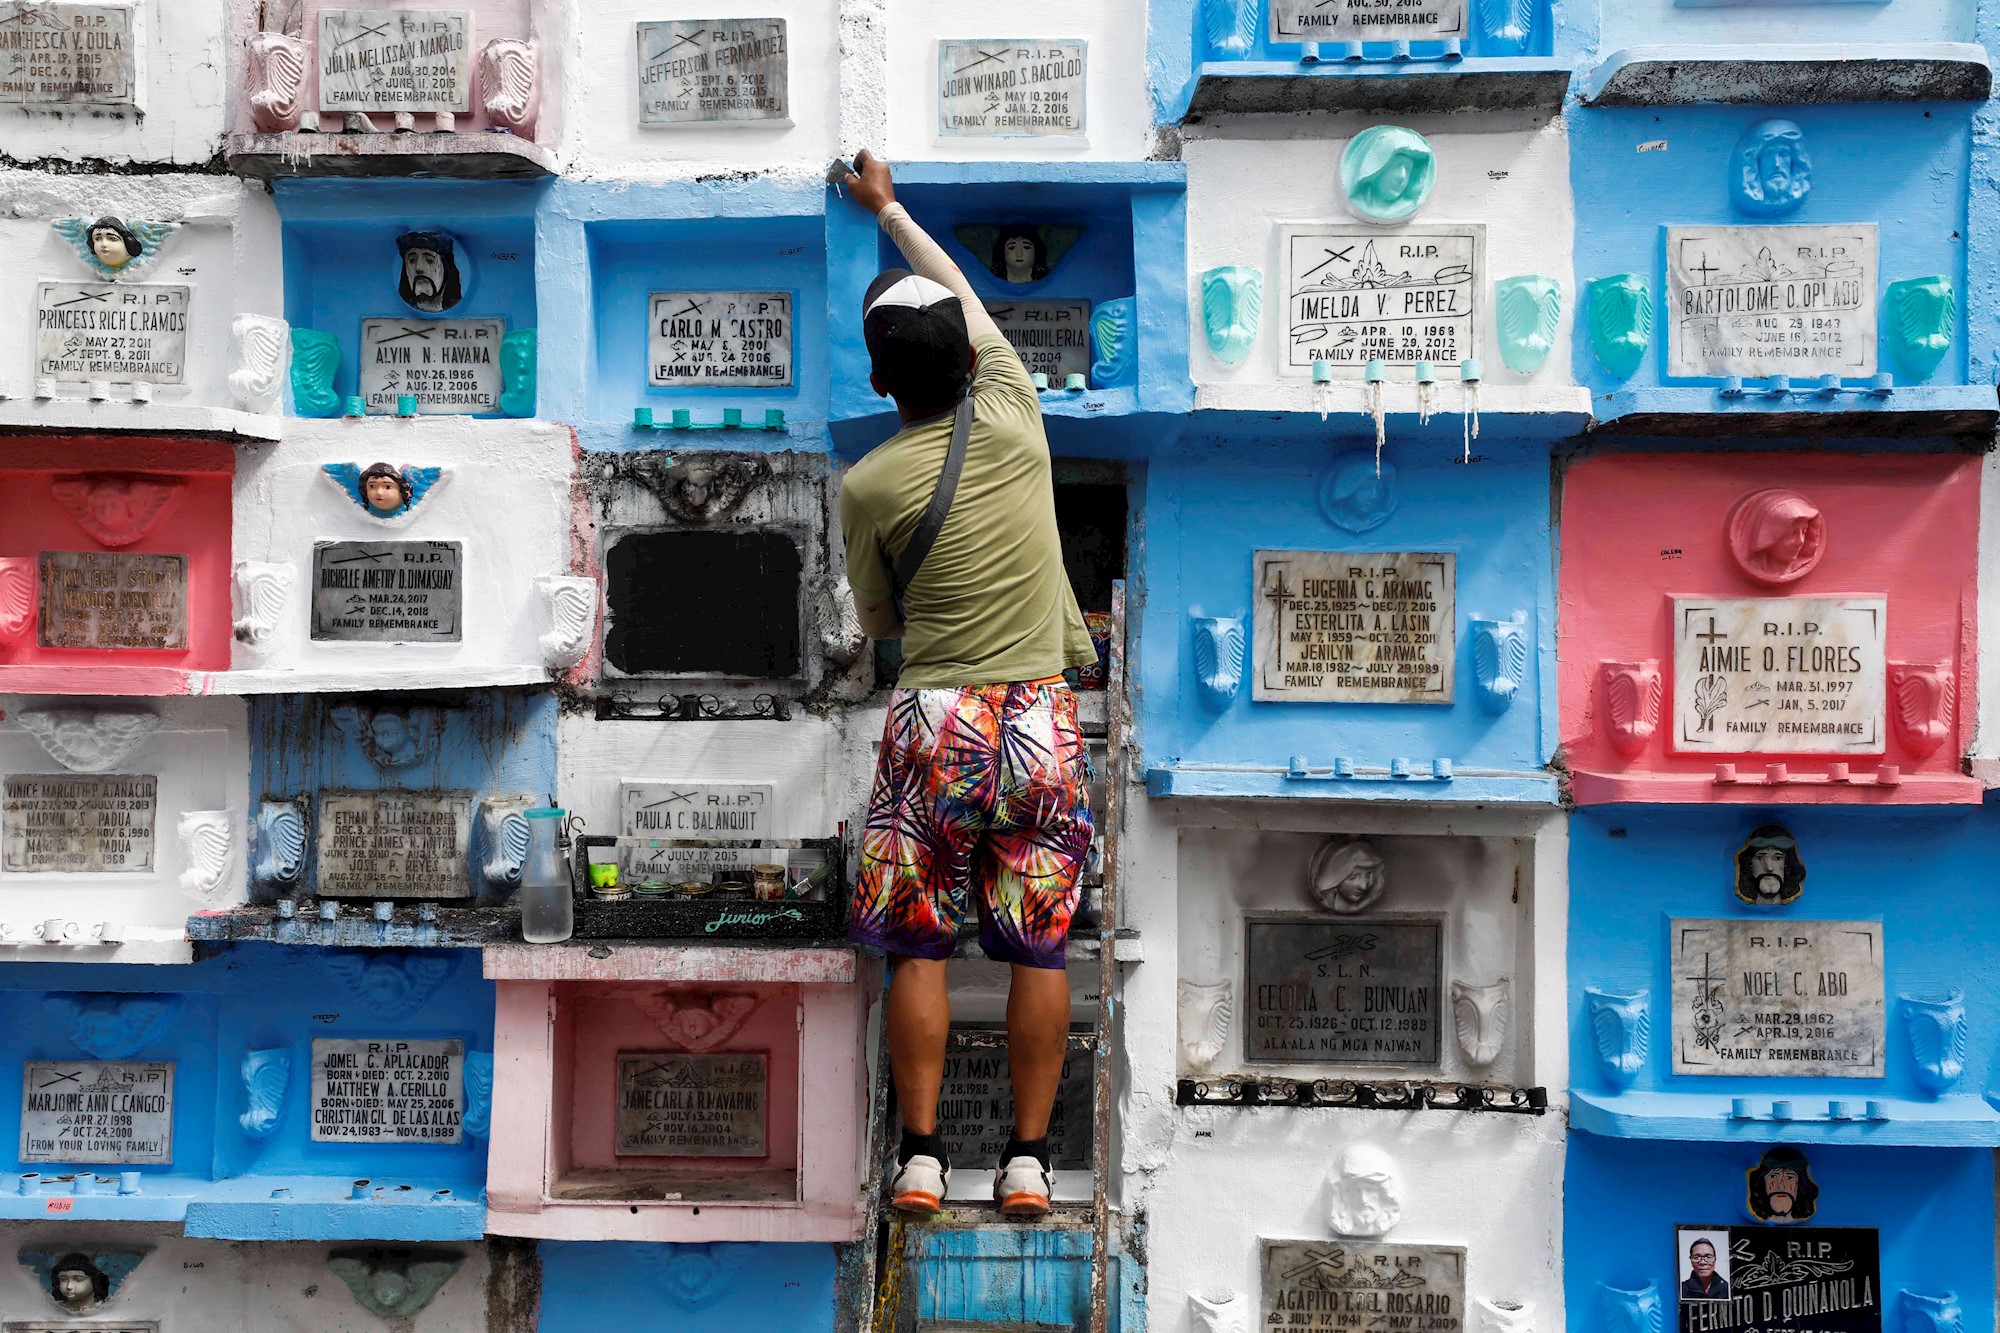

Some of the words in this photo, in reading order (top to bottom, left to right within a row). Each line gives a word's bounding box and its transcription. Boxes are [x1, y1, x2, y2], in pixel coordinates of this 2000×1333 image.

[1298, 15, 1339, 26] FAMILY
[1353, 13, 1438, 25] REMEMBRANCE
[87, 33, 121, 49] DULA
[642, 54, 708, 84] JEFFERSON
[716, 35, 784, 67] FERNANDEZ
[1017, 50, 1064, 59] R.I.P.
[326, 51, 356, 76] JULIA
[742, 75, 764, 84] 2012
[944, 77, 970, 97] JOHN
[974, 70, 1015, 92] WINARD
[334, 92, 370, 101] FAMILY
[375, 92, 453, 102] REMEMBRANCE
[1005, 92, 1026, 101] MAY
[656, 101, 689, 111] FAMILY
[700, 99, 774, 110] REMEMBRANCE
[1045, 104, 1068, 113] 2016
[953, 116, 987, 126] FAMILY
[995, 116, 1071, 126] REMEMBRANCE
[1400, 245, 1439, 258] R.I.P.
[1798, 247, 1848, 258] R.I.P.
[122, 294, 171, 304] R.I.P.
[1301, 296, 1359, 320] IMELDA
[1405, 290, 1456, 314] PEREZ
[1685, 285, 1779, 315] BARTOLOME
[39, 310, 95, 329] PRINCESS
[100, 311, 126, 330] RICH
[1025, 311, 1070, 321] R.I.P.
[445, 329, 489, 339] R.I.P.
[661, 319, 701, 338] CARLO
[86, 338, 107, 348] MAY
[1362, 339, 1394, 347] JUNE
[1426, 339, 1455, 347] 2012
[1756, 333, 1785, 342] JUNE
[1813, 332, 1841, 343] 2012
[376, 348, 410, 363] ALVIN
[442, 347, 490, 363] HAVANA
[742, 353, 770, 362] 2006
[1309, 349, 1354, 360] FAMILY
[1360, 349, 1456, 361] REMEMBRANCE
[1702, 348, 1743, 357] FAMILY
[1749, 347, 1842, 357] REMEMBRANCE
[49, 361, 84, 371] FAMILY
[90, 361, 172, 373] REMEMBRANCE
[661, 365, 701, 376] FAMILY
[705, 366, 781, 376] REMEMBRANCE
[449, 382, 477, 390] 2006
[404, 554, 442, 563] R.I.P.
[322, 569, 359, 588] RICHELLE
[1350, 568, 1399, 578] R.I.P.
[1303, 580, 1357, 599] EUGENIA
[1383, 581, 1432, 600] ARAWAG
[1412, 602, 1435, 611] 2016
[332, 620, 364, 628] FAMILY
[369, 620, 438, 628] REMEMBRANCE
[1296, 614, 1363, 630] ESTERLITA
[1392, 615, 1429, 631] LASIN
[1764, 623, 1822, 635] R.I.P.
[1291, 633, 1312, 642] MAY
[1328, 633, 1352, 642] 1959
[1415, 634, 1435, 643] 2011
[1301, 645, 1353, 660] JENILYN
[1376, 646, 1425, 661] ARAWAG
[1700, 646, 1751, 672] AIMIE
[1763, 647, 1779, 672] O.
[1788, 647, 1861, 672] FLORES
[1367, 664, 1393, 673] JULY
[1285, 676, 1323, 687] FAMILY
[1338, 677, 1426, 687] REMEMBRANCE
[1822, 700, 1845, 710] 2017
[1726, 722, 1767, 733] FAMILY
[1778, 723, 1863, 734] REMEMBRANCE
[103, 783, 151, 797] ATANACIO
[708, 795, 752, 805] R.I.P.
[99, 812, 131, 826] PADUA
[336, 812, 367, 824] ETHAN
[636, 812, 671, 830] PAULA
[693, 812, 756, 830] BALANQUIT
[334, 836, 366, 848] PRINCE
[372, 836, 403, 848] JAMES
[668, 852, 693, 861] JULY
[715, 851, 737, 860] 2015
[350, 860, 377, 871] JOSE
[406, 860, 438, 871] REYES
[636, 864, 670, 874] FAMILY
[336, 882, 368, 890] FAMILY
[376, 883, 451, 891] REMEMBRANCE
[1751, 937, 1812, 948] R.I.P.
[1744, 971, 1782, 997] NOEL
[1818, 972, 1847, 996] ABO
[1258, 985, 1317, 1011] CECILIA
[1365, 987, 1427, 1013] BUNUAN
[1807, 1028, 1834, 1038] 2016
[369, 1044, 409, 1052] R.I.P.
[1321, 1039, 1336, 1050] NG
[1343, 1039, 1368, 1051] MGA
[1375, 1041, 1420, 1051] NAIWAN
[1720, 1049, 1761, 1059] FAMILY
[1769, 1049, 1857, 1061] REMEMBRANCE
[325, 1054, 358, 1069] JOMEL
[384, 1055, 449, 1069] APLACADOR
[327, 1071, 352, 1079] BORN
[967, 1059, 1000, 1079] MAY
[328, 1082, 379, 1096] MATTHEW
[401, 1083, 446, 1097] CERILLO
[28, 1094, 84, 1112] MARJORIE
[87, 1095, 108, 1112] ANN
[123, 1096, 164, 1113] CANGCO
[388, 1100, 408, 1108] MAY
[429, 1100, 453, 1108] 2006
[655, 1091, 692, 1109] CARLA
[315, 1110, 368, 1124] CHRISTIAN
[371, 1111, 386, 1124] GIL
[410, 1111, 429, 1125] LAS
[432, 1112, 460, 1125] ALAS
[31, 1140, 54, 1150] FROM
[60, 1141, 82, 1150] YOUR
[88, 1141, 121, 1151] LOVING
[127, 1141, 158, 1151] FAMILY
[1788, 1242, 1832, 1258] R.I.P.
[1277, 1290, 1338, 1311] AGAPITO
[1387, 1294, 1449, 1314] ROSARIO
[1783, 1276, 1873, 1323] QUIÑANOLA
[1288, 1314, 1313, 1324] JULY
[1390, 1317, 1413, 1328] MAY
[1429, 1319, 1457, 1329] 2009
